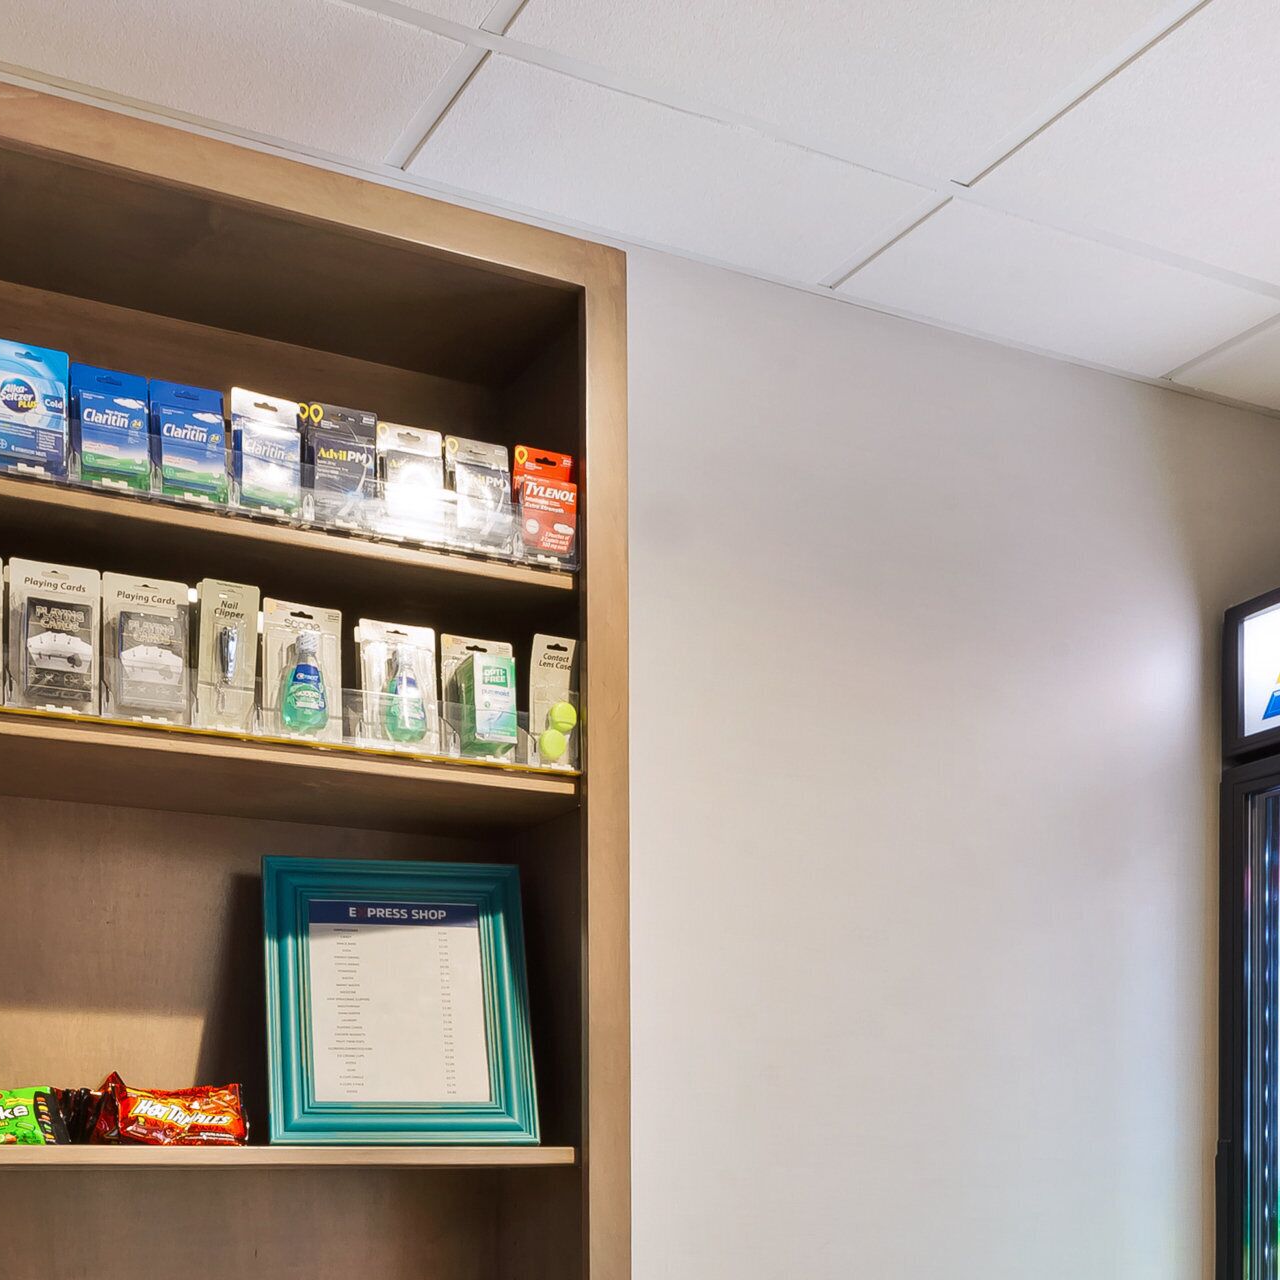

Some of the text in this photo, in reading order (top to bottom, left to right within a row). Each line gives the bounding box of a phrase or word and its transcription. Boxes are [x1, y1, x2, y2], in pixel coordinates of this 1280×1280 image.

[45, 399, 63, 408] Cold
[83, 408, 128, 427] Claritin
[162, 423, 207, 443] Claritin
[525, 481, 576, 502] TYLENOL
[24, 576, 86, 593] Playing Cards
[116, 590, 176, 605] Playing Cards
[220, 600, 239, 610] Nail
[35, 605, 85, 623] PLAYING
[40, 617, 81, 633] CARDS
[543, 653, 570, 662] Contact
[539, 660, 572, 671] Lens Case
[411, 909, 446, 920] SHOP
